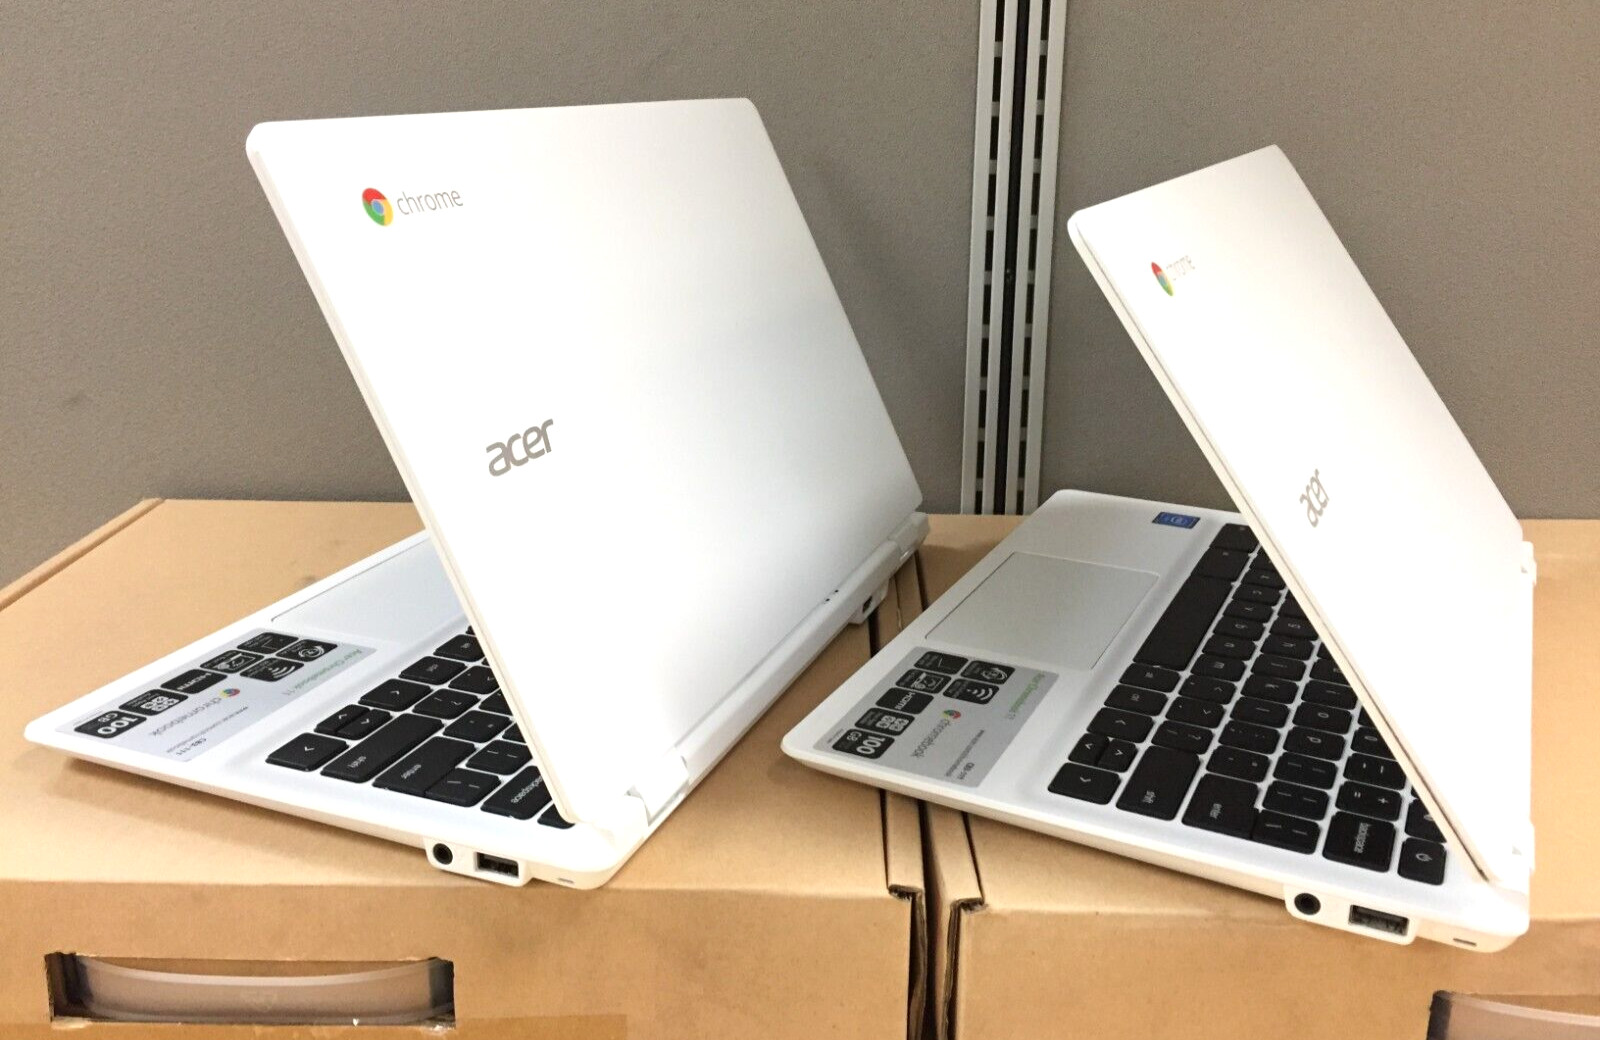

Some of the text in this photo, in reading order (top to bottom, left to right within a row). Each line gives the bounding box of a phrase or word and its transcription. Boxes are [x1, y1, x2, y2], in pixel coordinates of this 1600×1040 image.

[396, 190, 463, 216] chrome
[485, 418, 554, 477] acer
[1300, 469, 1330, 528] acer
[97, 712, 119, 723] GB
[97, 716, 138, 735] 100
[149, 697, 222, 736] chromebook
[846, 730, 863, 742] GB
[856, 735, 886, 755] 100
[911, 718, 950, 759] chromebook
[510, 775, 543, 804] ackspace
